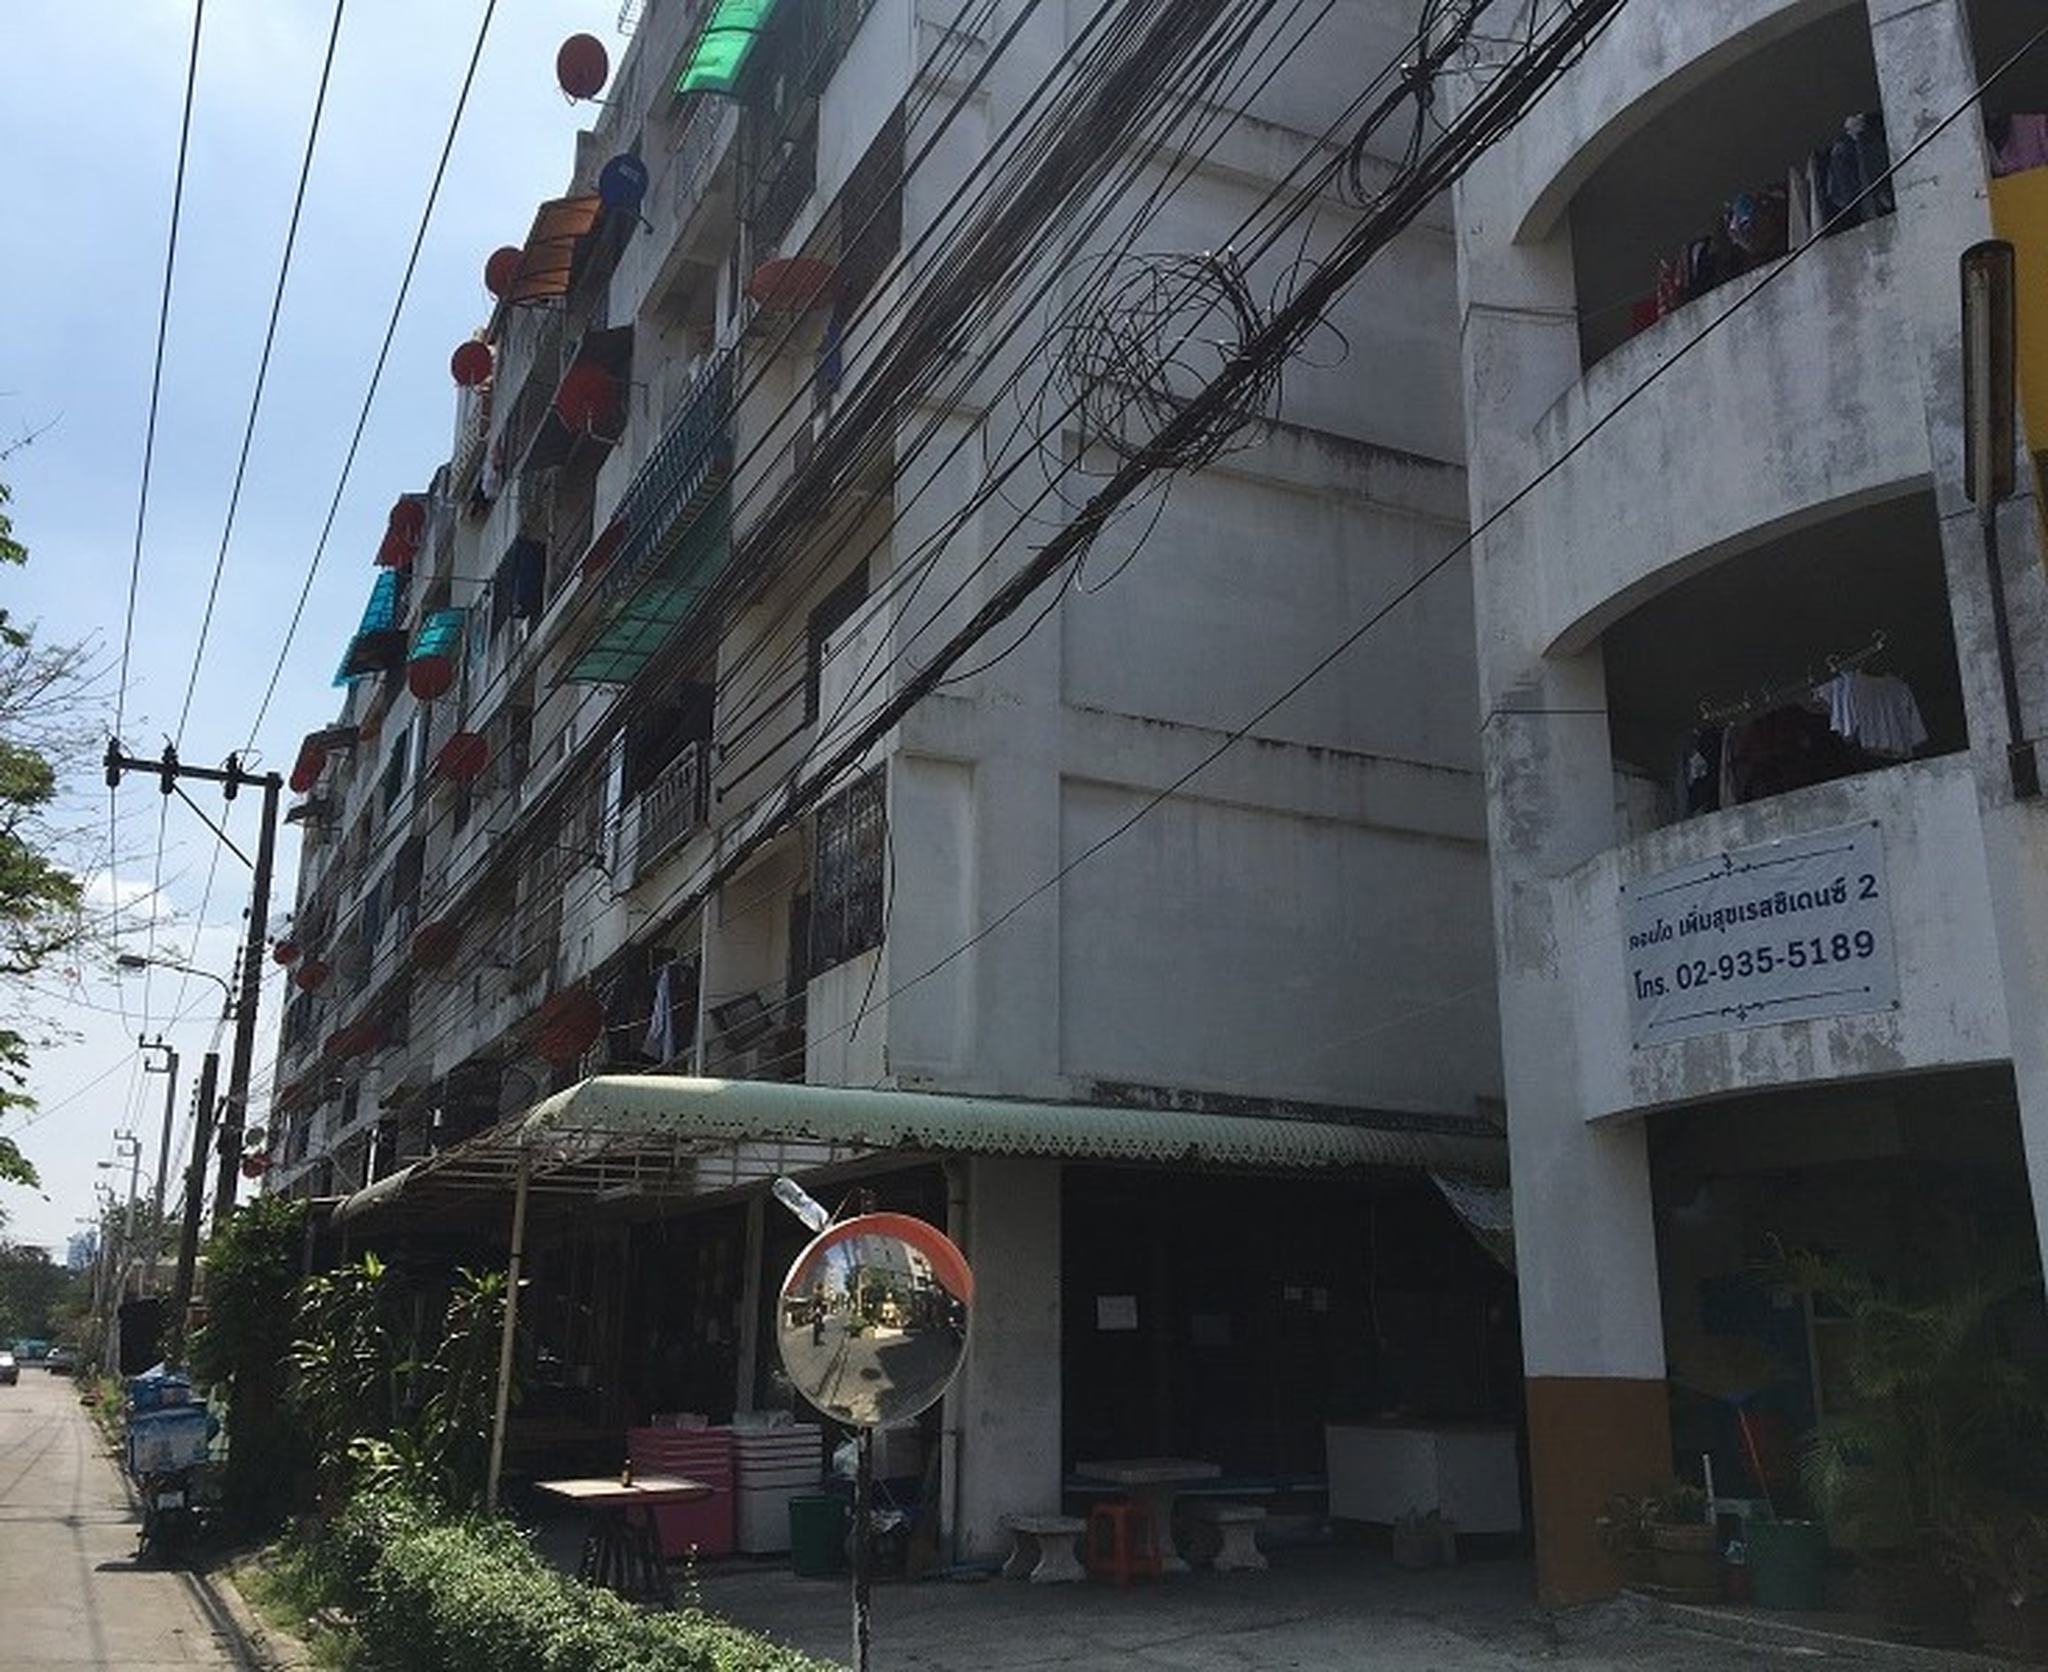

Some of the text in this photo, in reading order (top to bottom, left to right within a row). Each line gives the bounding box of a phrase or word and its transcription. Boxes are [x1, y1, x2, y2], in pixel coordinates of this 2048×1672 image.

[1858, 874, 1879, 900] 2
[1633, 930, 1875, 1000] โทร. 02-935-5189
